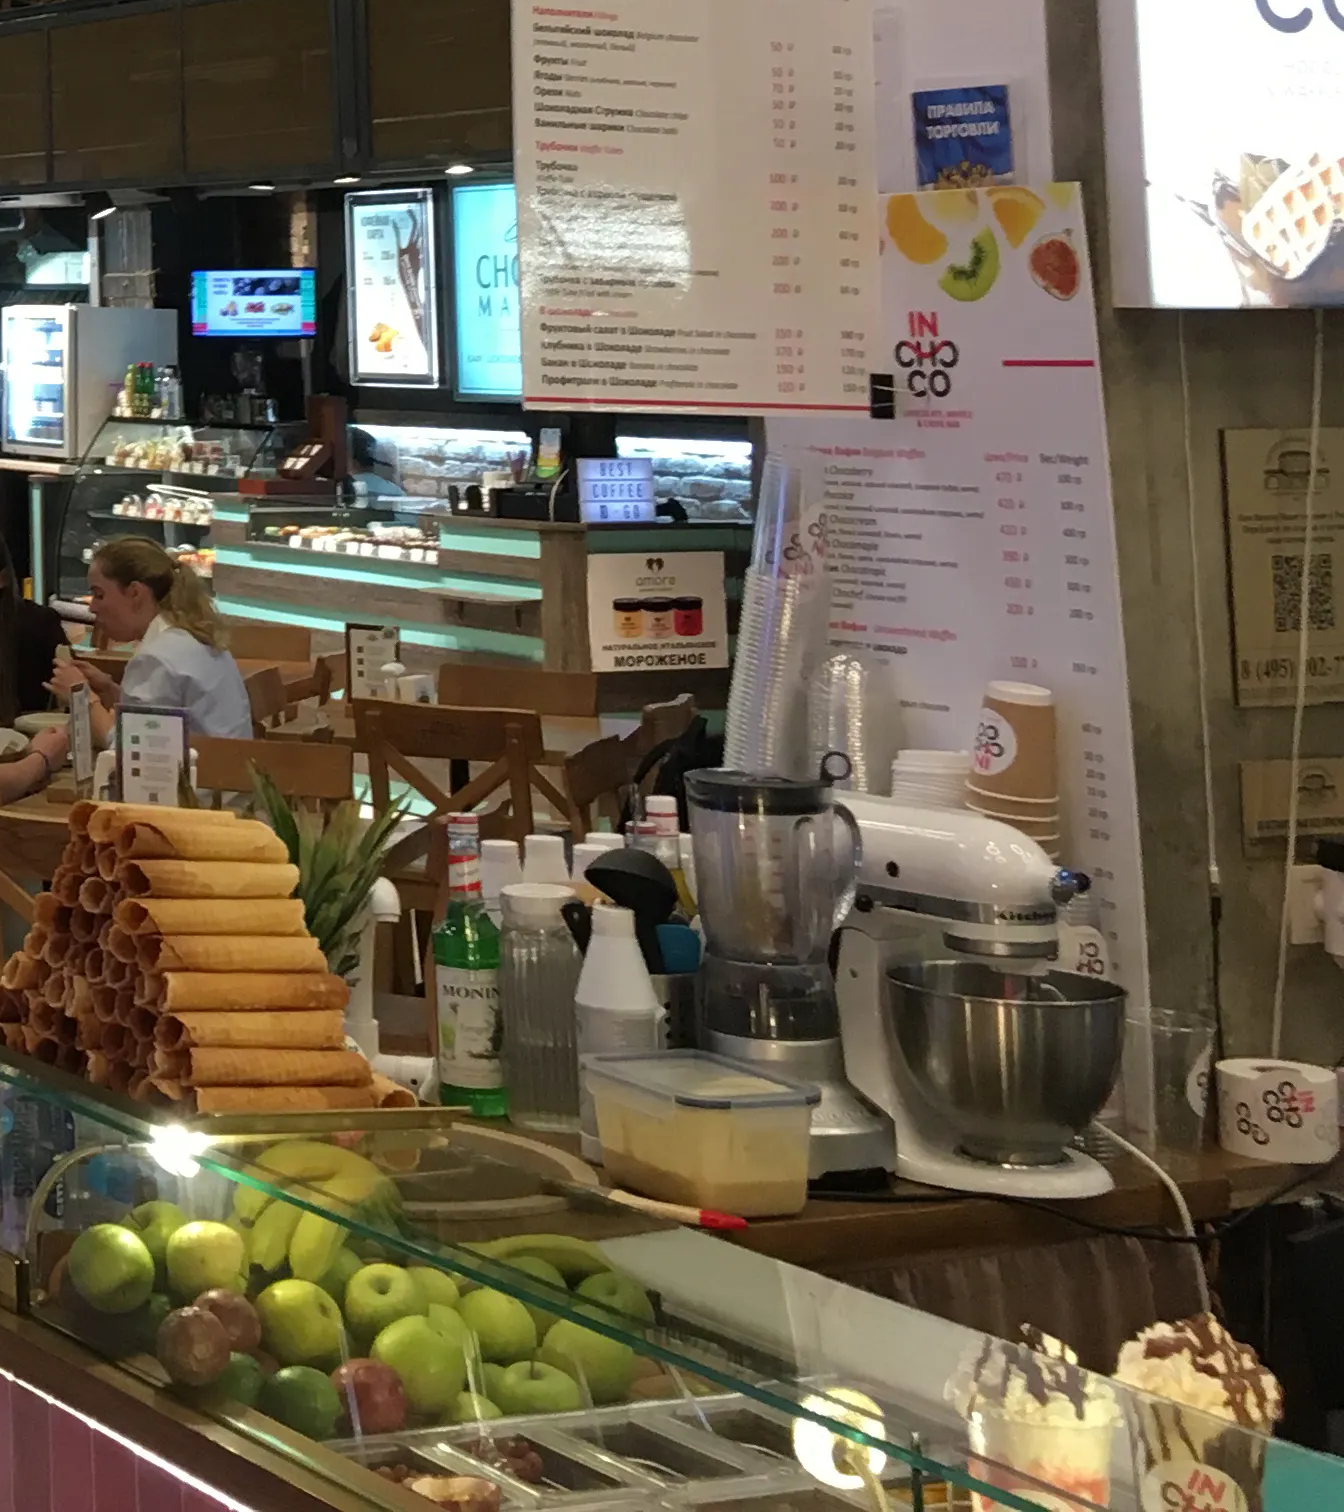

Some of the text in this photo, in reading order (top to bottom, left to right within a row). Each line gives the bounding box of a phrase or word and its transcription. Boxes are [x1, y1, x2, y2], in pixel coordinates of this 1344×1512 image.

[927, 101, 995, 119] ПРАВИЛА
[908, 311, 939, 337] IN
[907, 370, 951, 397] CO
[600, 462, 633, 477] BEST
[592, 483, 644, 499] COFFEE
[614, 652, 707, 668] МОРОЖЕНОЕ
